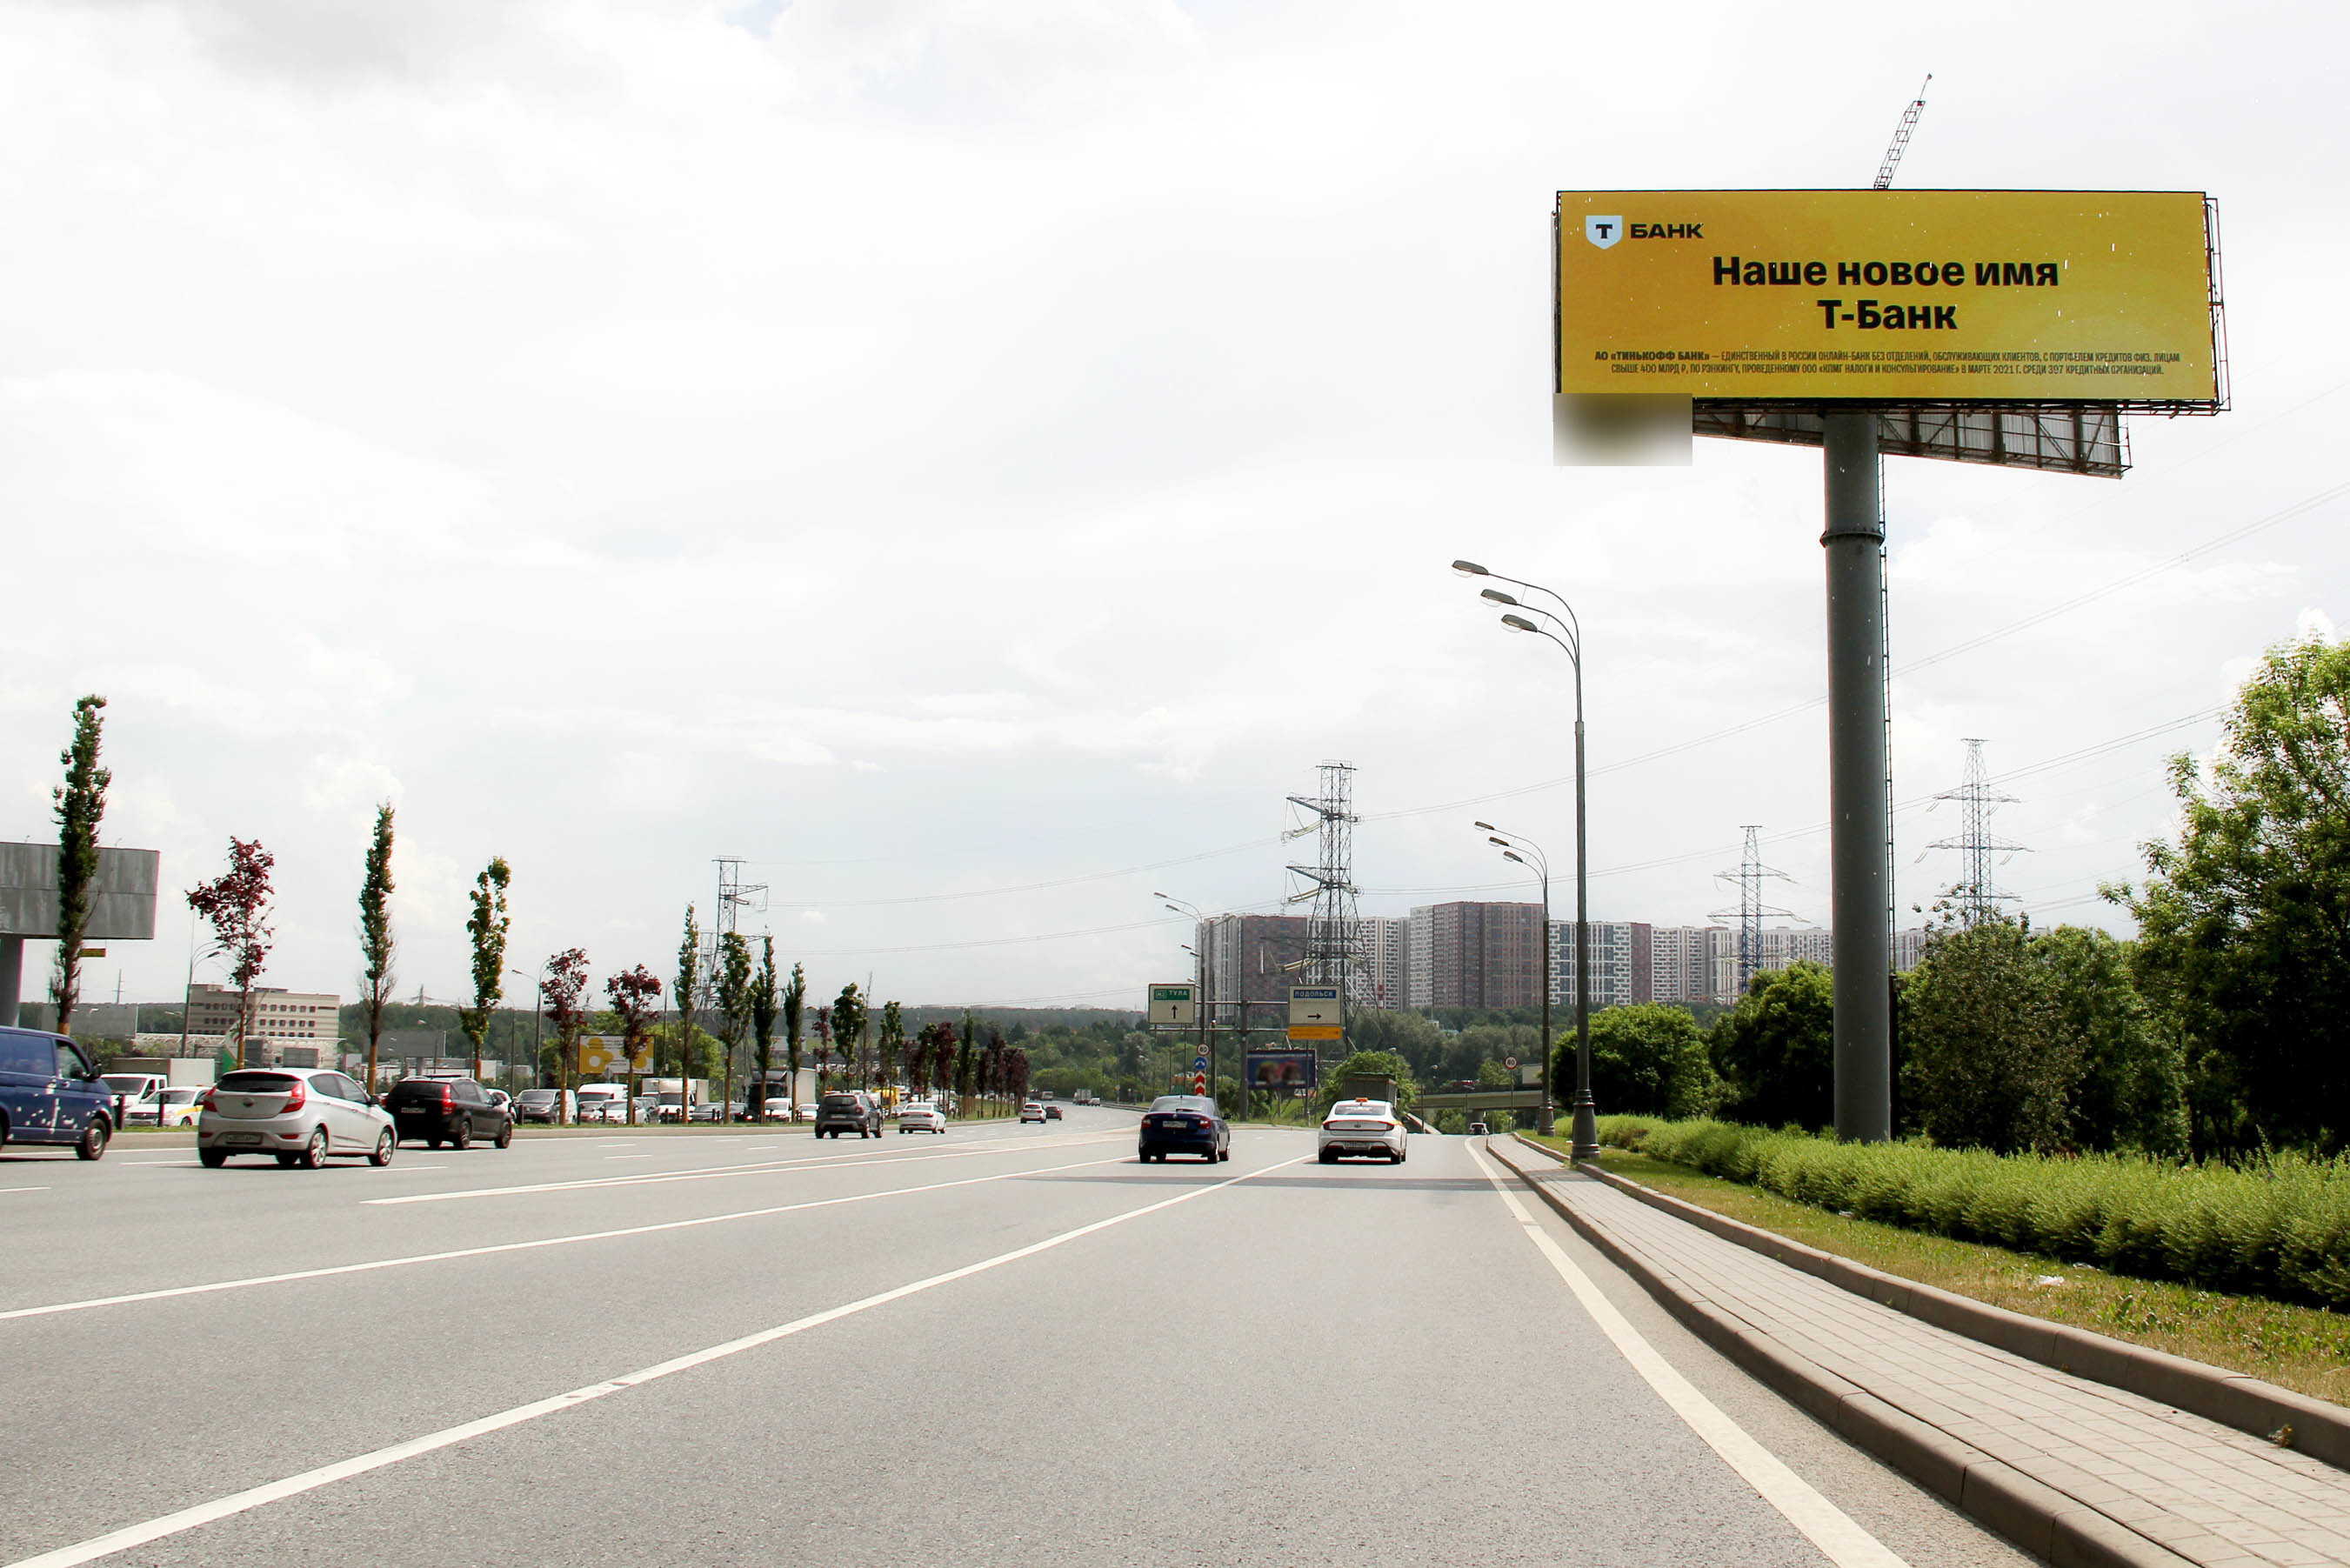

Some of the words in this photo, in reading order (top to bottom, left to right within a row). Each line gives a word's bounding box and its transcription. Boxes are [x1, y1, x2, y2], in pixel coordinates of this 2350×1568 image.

[1630, 223, 1705, 239] БАНК
[1712, 256, 1827, 286] Наше
[1838, 260, 1966, 286] новое
[1975, 261, 2059, 286] имя
[1817, 299, 1958, 330] Т-Банк
[1595, 350, 1608, 361] АО
[1611, 350, 1675, 361] «ТИНЬКОФФ
[1678, 350, 1710, 361] БАНК»
[1721, 350, 1780, 361] ЕДИНСТВЕННЫЙ
[1781, 351, 1787, 362] В
[1788, 351, 1817, 362] РОССИИ
[1818, 351, 1871, 362] ОНЛАЙН-БАНК
[1872, 351, 1885, 362] БЕЗ
[1933, 351, 2000, 362] ОБСЛУЖИВАЮЩИХ
[2043, 351, 2048, 362] С
[2049, 351, 2093, 362] ПОРТФЕЛЕМ
[2095, 351, 2132, 362] КРЕДИТОВ
[2133, 351, 2153, 362] ФИЗ.
[2153, 352, 2180, 363] ЛИЦАМ
[1611, 364, 1639, 374] СВЫШЕ
[1640, 364, 1657, 374] 400
[1658, 364, 1680, 374] МЛРД
[1691, 364, 1700, 374] ПО
[1701, 364, 1740, 374] РЭНКИНГУ,
[1742, 364, 1800, 375] ПРОВЕДЕННОМУ
[1801, 364, 1817, 375] ООО
[1819, 364, 1843, 375] «КПМГ
[1845, 364, 1873, 375] НАЛОГИ
[1875, 364, 1880, 375] И
[1882, 364, 1959, 375] КОНСУЛЬТИРОВАНИЕ»
[1961, 364, 1966, 375] В
[1968, 364, 1992, 375] МАРТЕ
[1993, 364, 2014, 375] 2021
[2015, 364, 2022, 375] Г.
[2023, 365, 2046, 376] СРЕДИ
[2048, 365, 2063, 376] 397
[2066, 365, 2110, 376] КРЕДИТНЫХ
[2111, 365, 2165, 376] ОРГАНИЗАЦИЙ.
